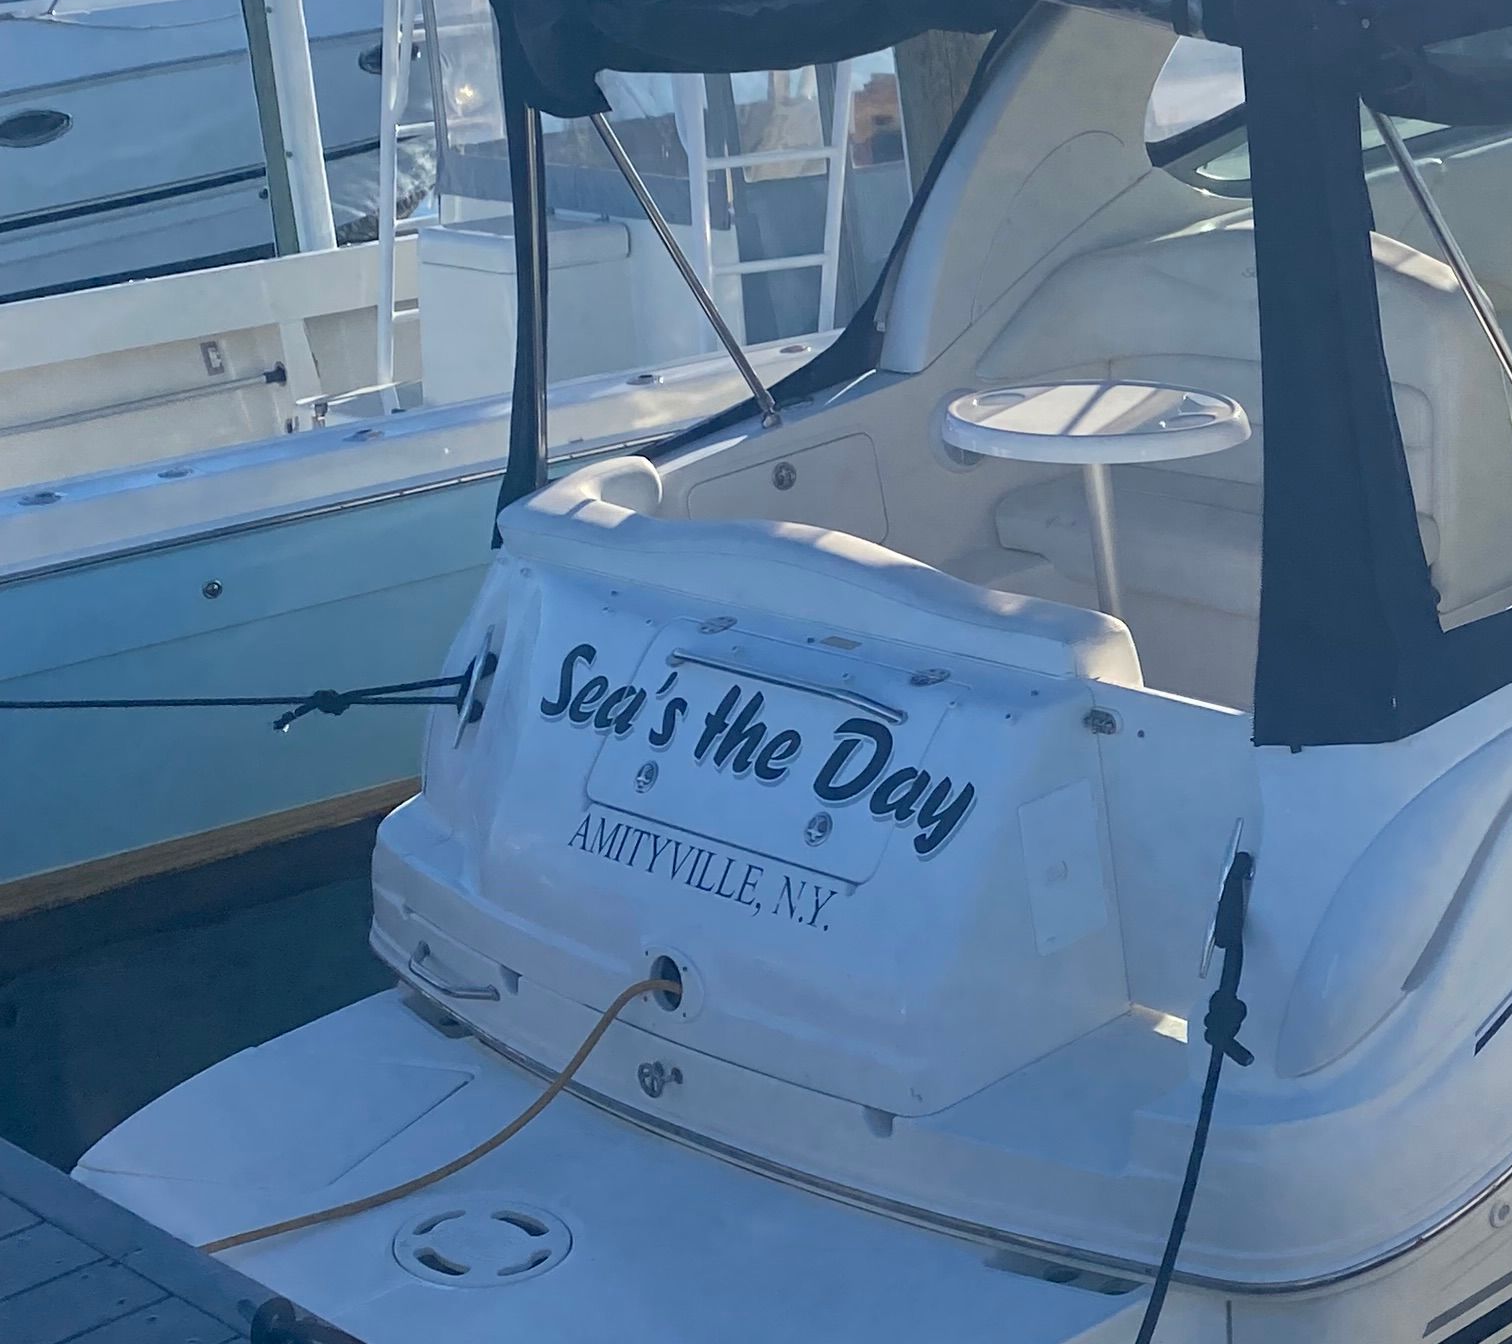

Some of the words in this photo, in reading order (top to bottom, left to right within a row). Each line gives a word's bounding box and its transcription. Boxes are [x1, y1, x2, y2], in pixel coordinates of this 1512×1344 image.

[540, 643, 689, 747] Sea's
[693, 683, 802, 781] the
[811, 716, 977, 859] Day
[568, 813, 764, 918] AMITYVILLE,
[773, 874, 837, 933] N.Y.
